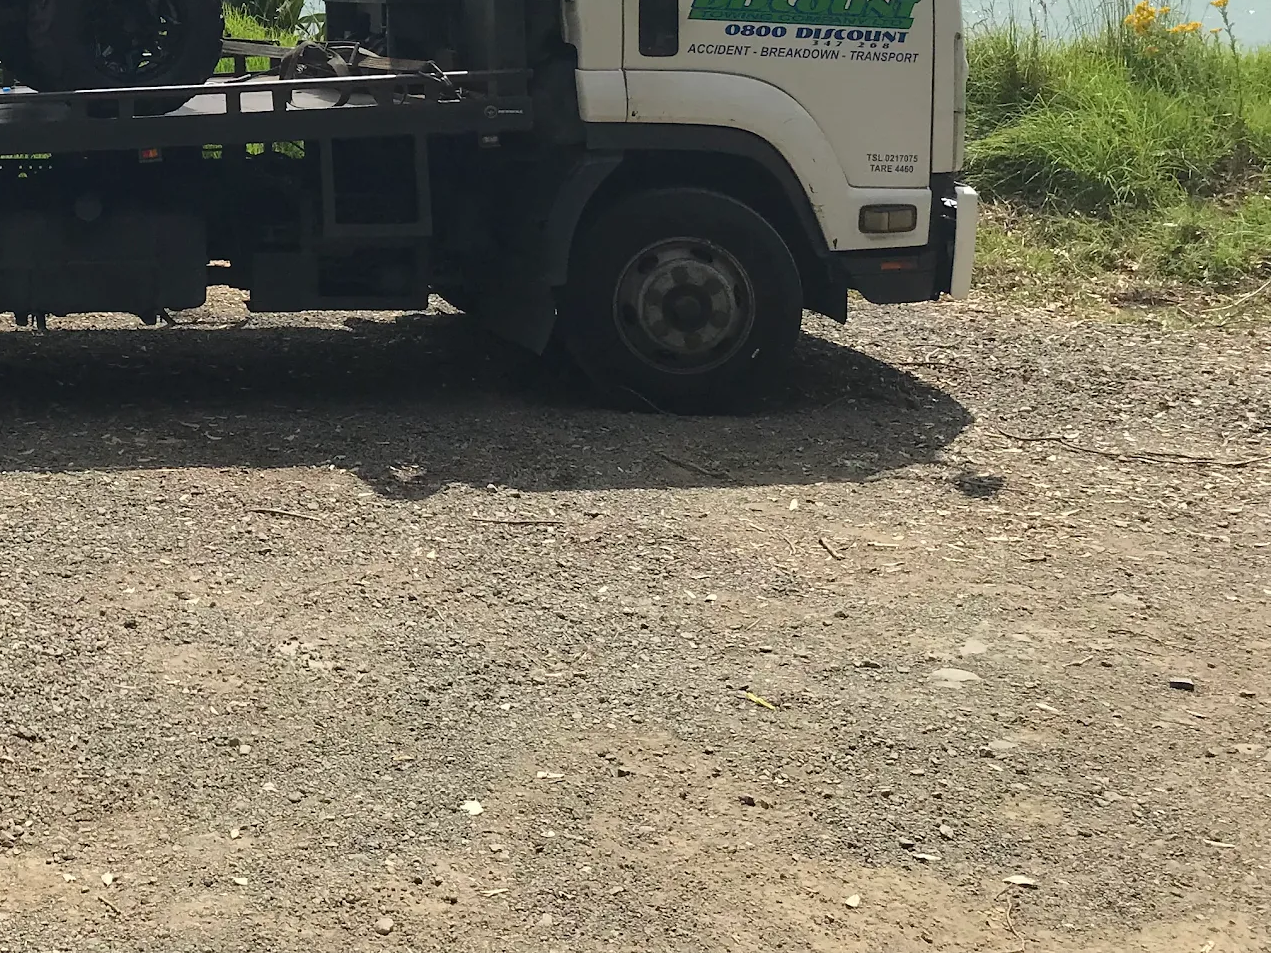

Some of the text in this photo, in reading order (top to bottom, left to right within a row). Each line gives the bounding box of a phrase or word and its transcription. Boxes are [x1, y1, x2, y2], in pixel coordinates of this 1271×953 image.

[701, 10, 772, 20] TOWING
[778, 14, 869, 25] COMPANY
[725, 24, 909, 43] 0800 DISCOUNT
[687, 43, 751, 56] ACCIDENT
[760, 46, 839, 60] BREAKDOWN
[849, 50, 919, 63] TRANSPORT
[867, 153, 883, 162] TSL
[870, 164, 893, 173] TARE
